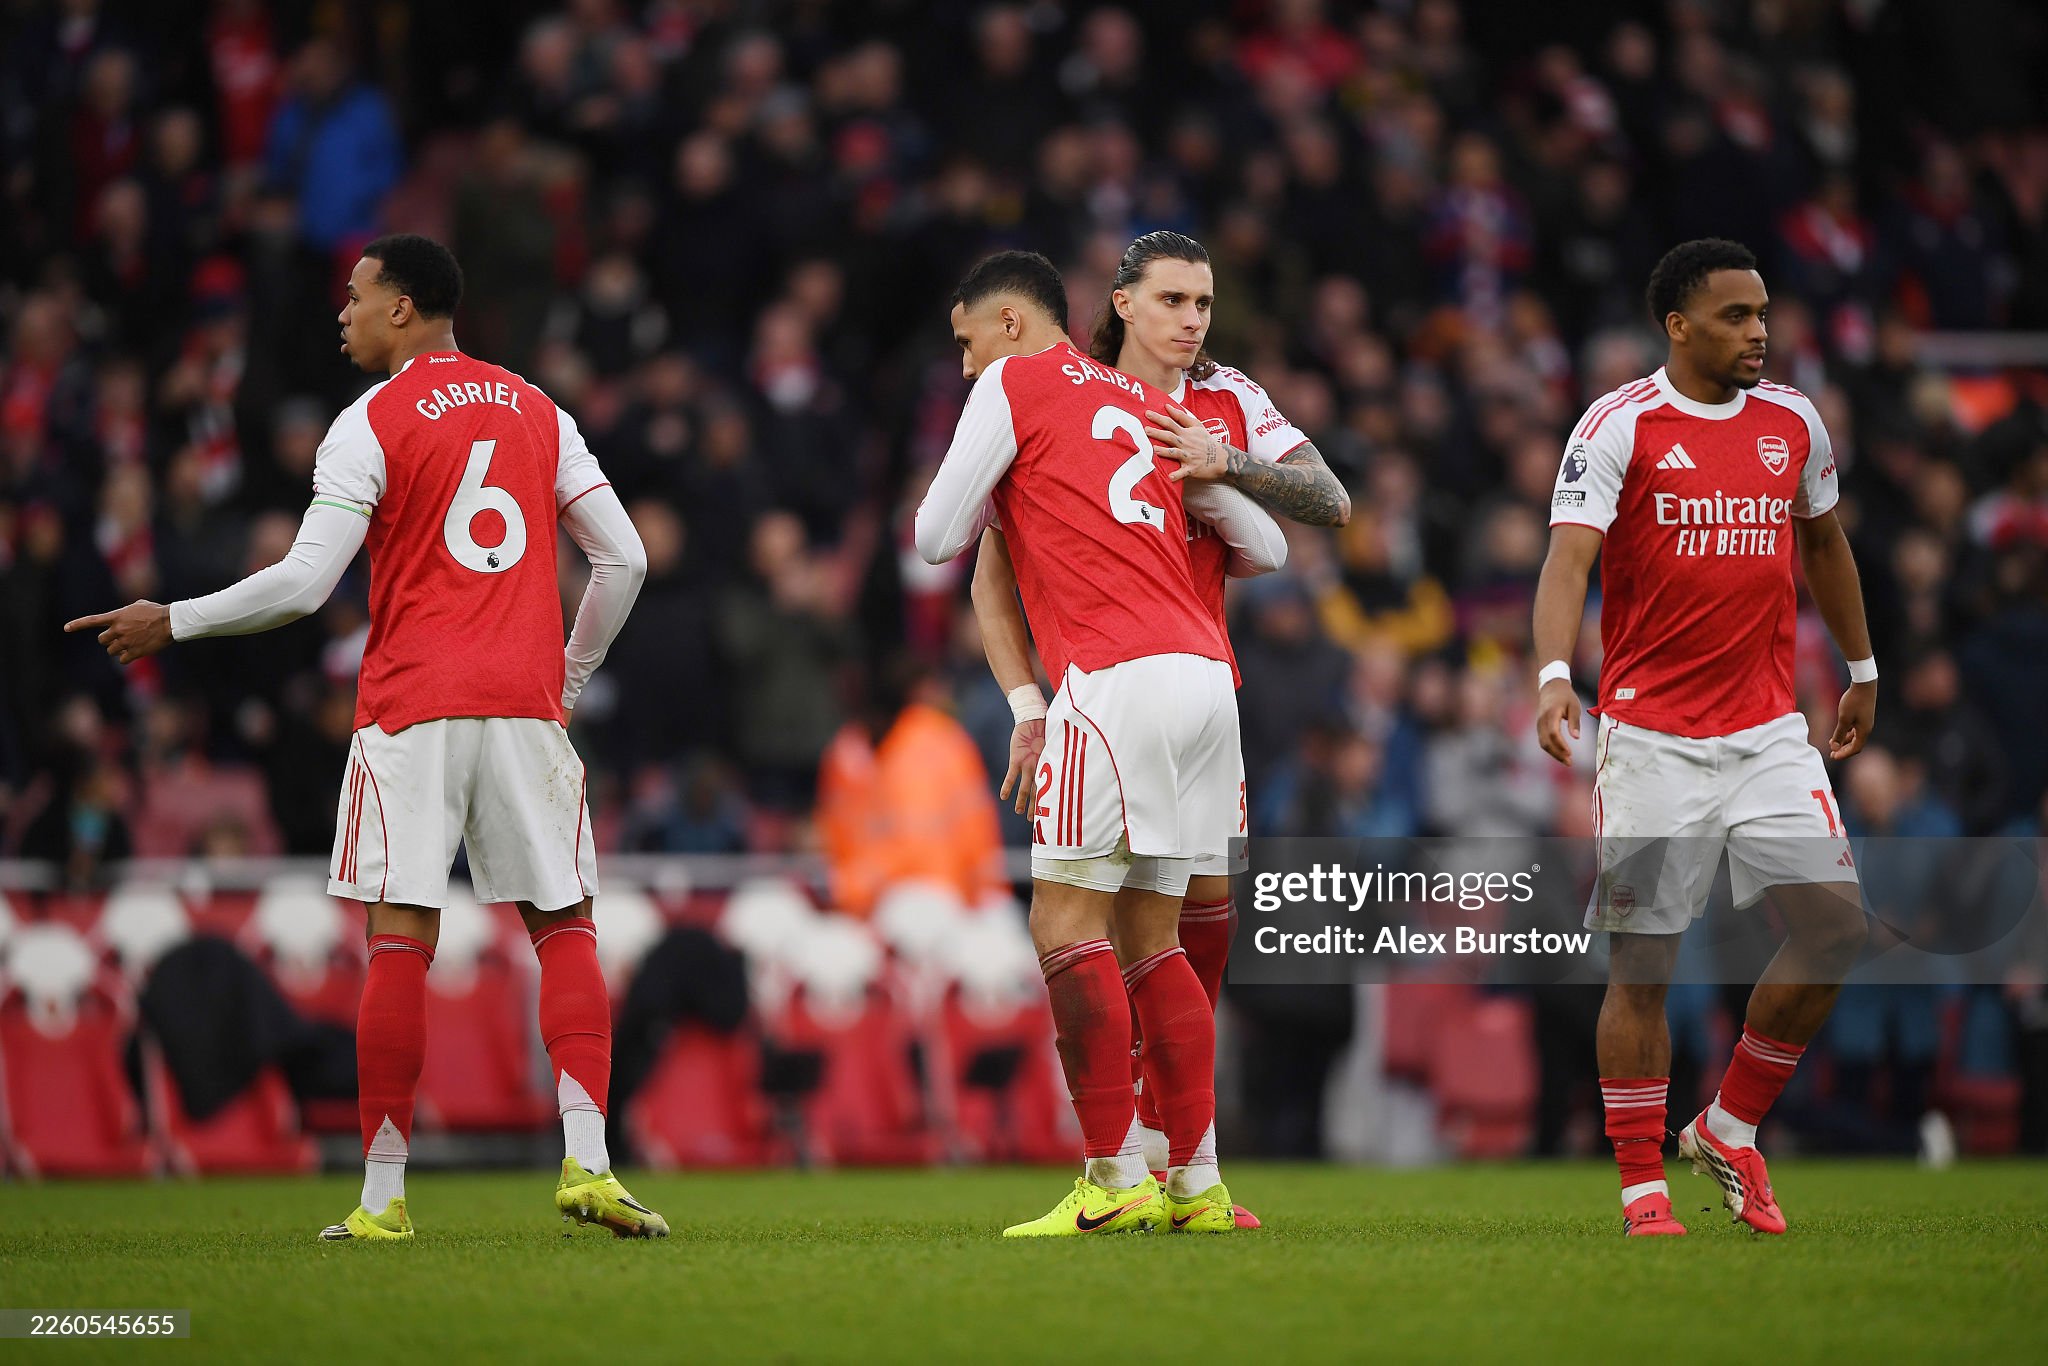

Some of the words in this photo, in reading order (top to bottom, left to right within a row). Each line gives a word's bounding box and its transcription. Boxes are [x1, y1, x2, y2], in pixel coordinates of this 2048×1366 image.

[428, 354, 459, 365] Arsenal
[415, 381, 522, 420] GABRIEL
[1061, 360, 1145, 402] SALIBA
[1762, 442, 1785, 450] Arsenal
[1091, 405, 1166, 534] 2
[443, 439, 527, 574] 6
[1653, 490, 1792, 525] Emirates
[1676, 529, 1710, 556] FLY
[1716, 529, 1776, 556] BETTER
[1035, 762, 1053, 818] 2
